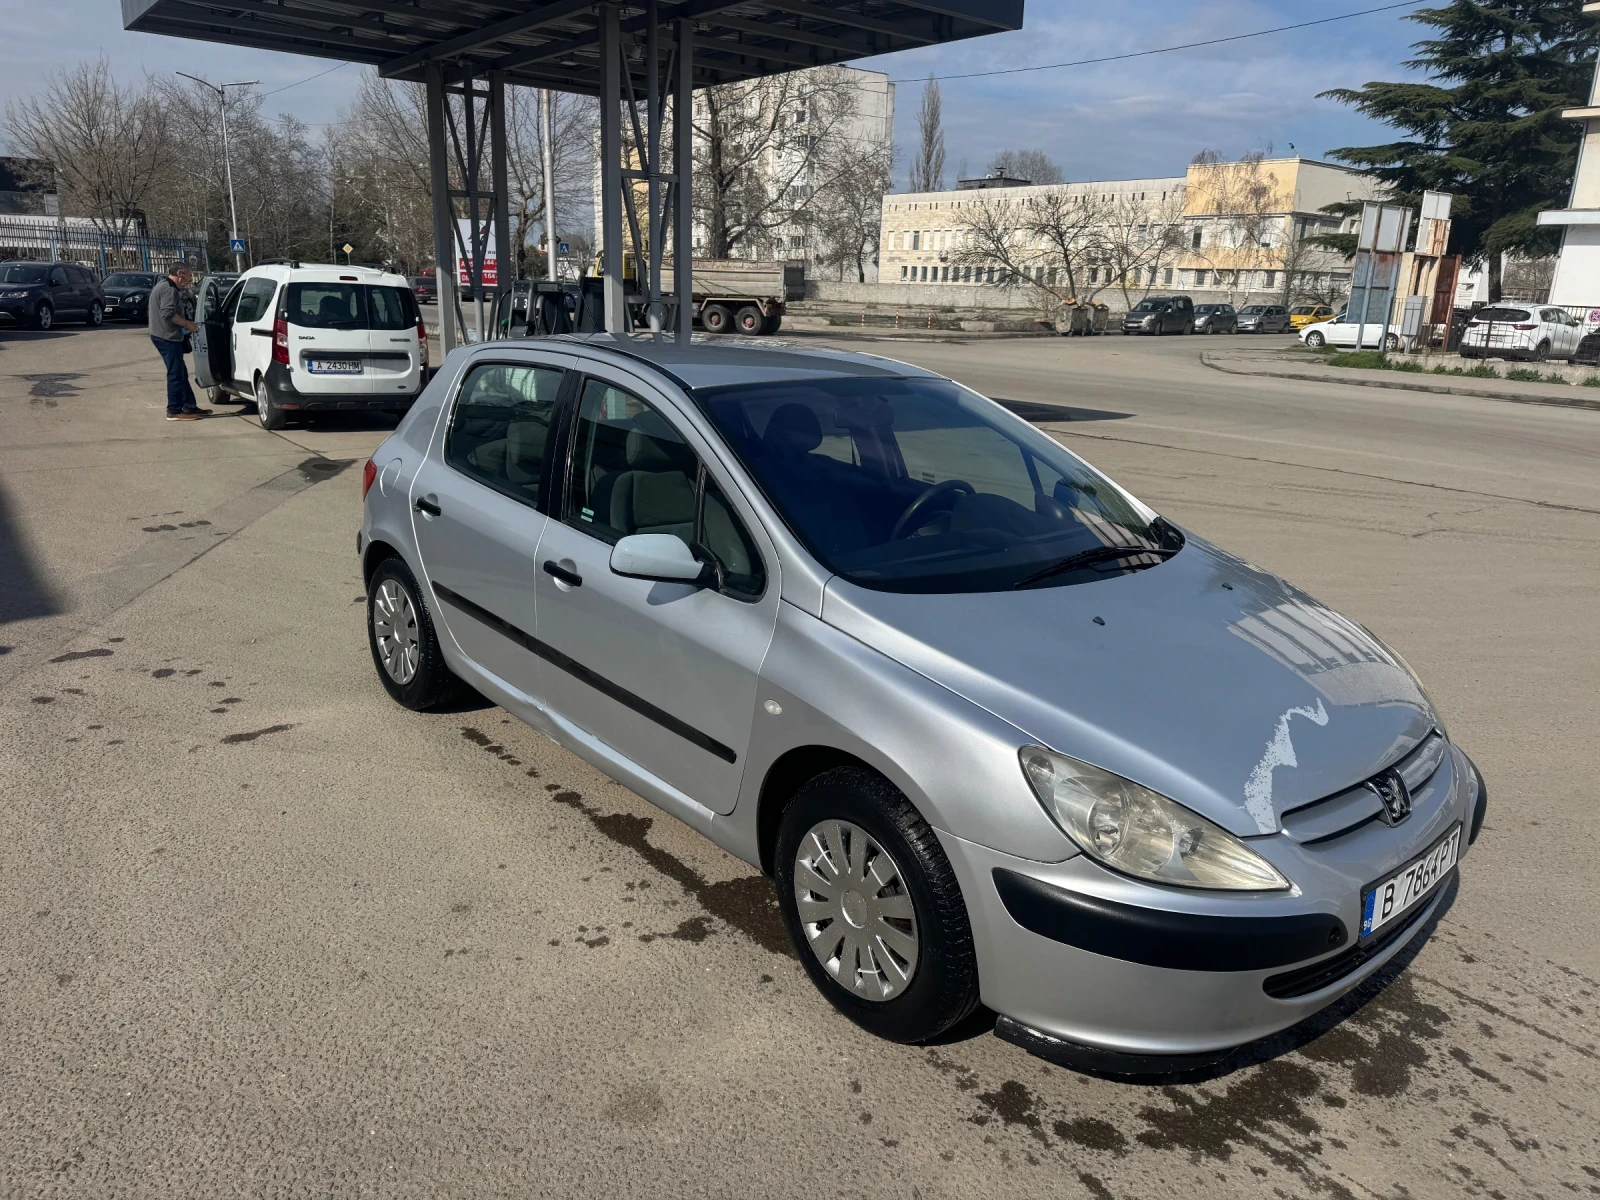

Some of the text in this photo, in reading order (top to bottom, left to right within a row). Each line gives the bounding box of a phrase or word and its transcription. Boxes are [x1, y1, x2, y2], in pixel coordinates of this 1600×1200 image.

[514, 298, 528, 309] 1 3
[1381, 882, 1395, 919] B
